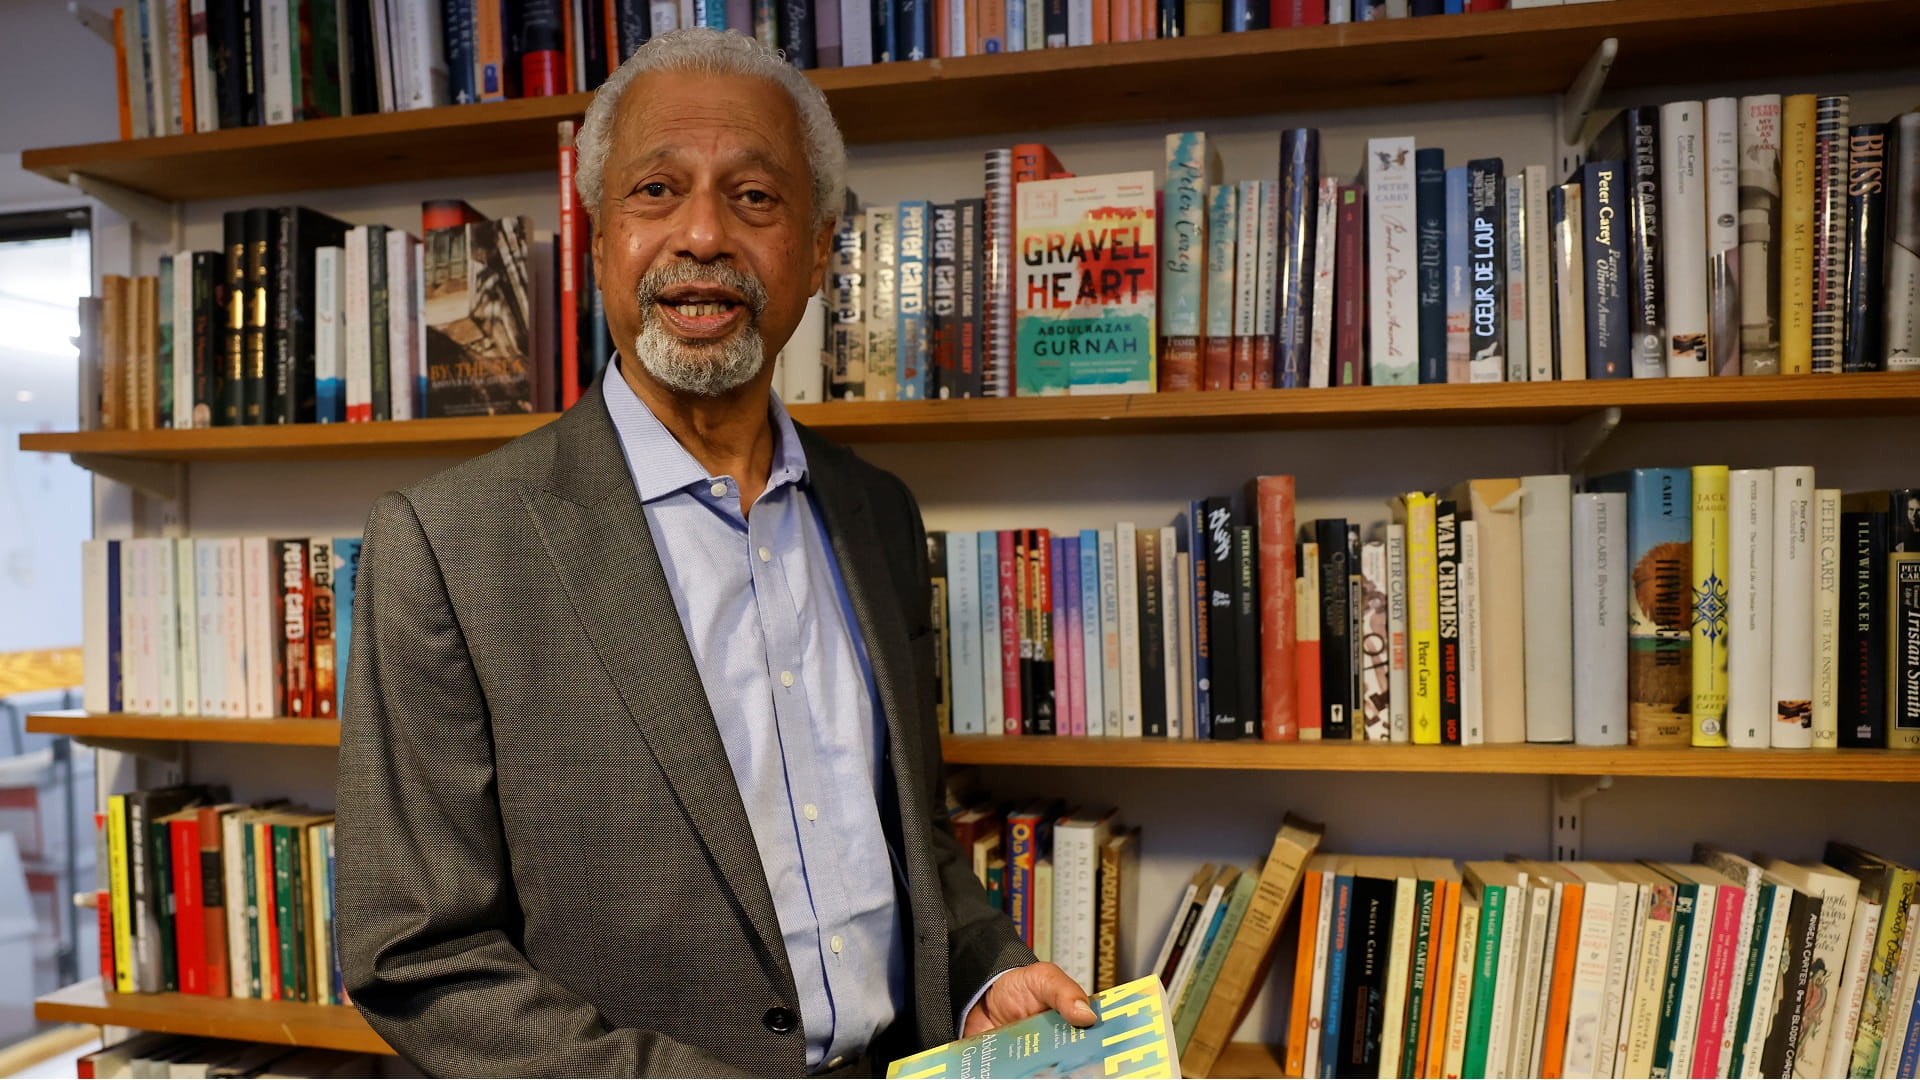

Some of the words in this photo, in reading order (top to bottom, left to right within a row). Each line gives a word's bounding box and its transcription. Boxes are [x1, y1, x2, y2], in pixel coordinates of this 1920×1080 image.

[1635, 125, 1653, 178] PETER
[1686, 154, 1696, 177] Carey
[1849, 134, 1884, 197] BLISS
[1178, 163, 1200, 214] Peter
[1597, 170, 1613, 203] Peter
[1474, 217, 1495, 259] LOUP
[1596, 205, 1614, 246] Carey
[1023, 226, 1151, 267] GRAVEL
[1168, 219, 1198, 274] Carey
[1608, 248, 1620, 283] Parrot
[1027, 268, 1146, 310] HEART
[1475, 262, 1494, 281] DE
[1596, 258, 1609, 295] Olivier
[1643, 264, 1654, 302] ILLEGAL
[1038, 323, 1133, 336] ABDULRAZAK
[1597, 303, 1609, 347] America
[1645, 303, 1655, 326] SELF
[1033, 338, 1138, 357] GURNAH
[1662, 475, 1673, 517] CAREY
[1798, 500, 1807, 520] Peter
[1438, 512, 1455, 558] WAR
[1598, 502, 1608, 534] PETER
[1797, 521, 1807, 544] Carey
[1820, 498, 1836, 545] PETER
[1103, 542, 1115, 583] PETER
[1241, 529, 1251, 557] PETER
[1390, 537, 1403, 580] PETER
[1598, 535, 1608, 571] CAREY
[1241, 557, 1251, 588] CAREY
[1412, 546, 1434, 632] Crimes
[1821, 546, 1835, 593] CAREY
[1857, 521, 1870, 632] ILLYWHACKER
[1000, 561, 1015, 667] CAREY
[1104, 583, 1116, 623] CAREY
[1391, 580, 1405, 623] CAREY
[1438, 560, 1457, 639] CRIMES
[1822, 609, 1833, 628] THE
[1417, 641, 1430, 666] Peter
[1445, 643, 1454, 673] PETER
[1822, 633, 1833, 652] TAX
[1417, 668, 1431, 699] Carey
[1446, 674, 1456, 704] CAREY
[1822, 656, 1833, 708] INSPECTOR
[1907, 669, 1920, 718] Smith
[1012, 824, 1030, 853] OLD
[1077, 841, 1089, 922] ANGELA
[1101, 858, 1117, 921] SADEIAN
[1490, 891, 1498, 907] THE
[1368, 899, 1380, 936] ANGELA
[1419, 888, 1433, 937] ANGELA
[1462, 913, 1475, 939] Angela
[1487, 909, 1497, 938] MAGIC
[1617, 894, 1631, 938] ANGELA
[1695, 891, 1709, 938] ANGELA
[1771, 892, 1787, 940] ANGELA
[1804, 913, 1819, 950] ANGELA
[1099, 921, 1116, 983] WOMAN
[1365, 939, 1378, 976] CARTER
[1413, 940, 1427, 990] CARTER
[1483, 939, 1494, 979] TOYSHOP
[1611, 941, 1627, 986] CARTER
[1689, 942, 1707, 991] CARTER
[1763, 944, 1778, 992] CARTER
[1799, 949, 1811, 987] CARTER
[1451, 1028, 1463, 1052] FIRE
[1787, 1014, 1802, 1048] BLOODY
[961, 1046, 977, 1079] Gurna
